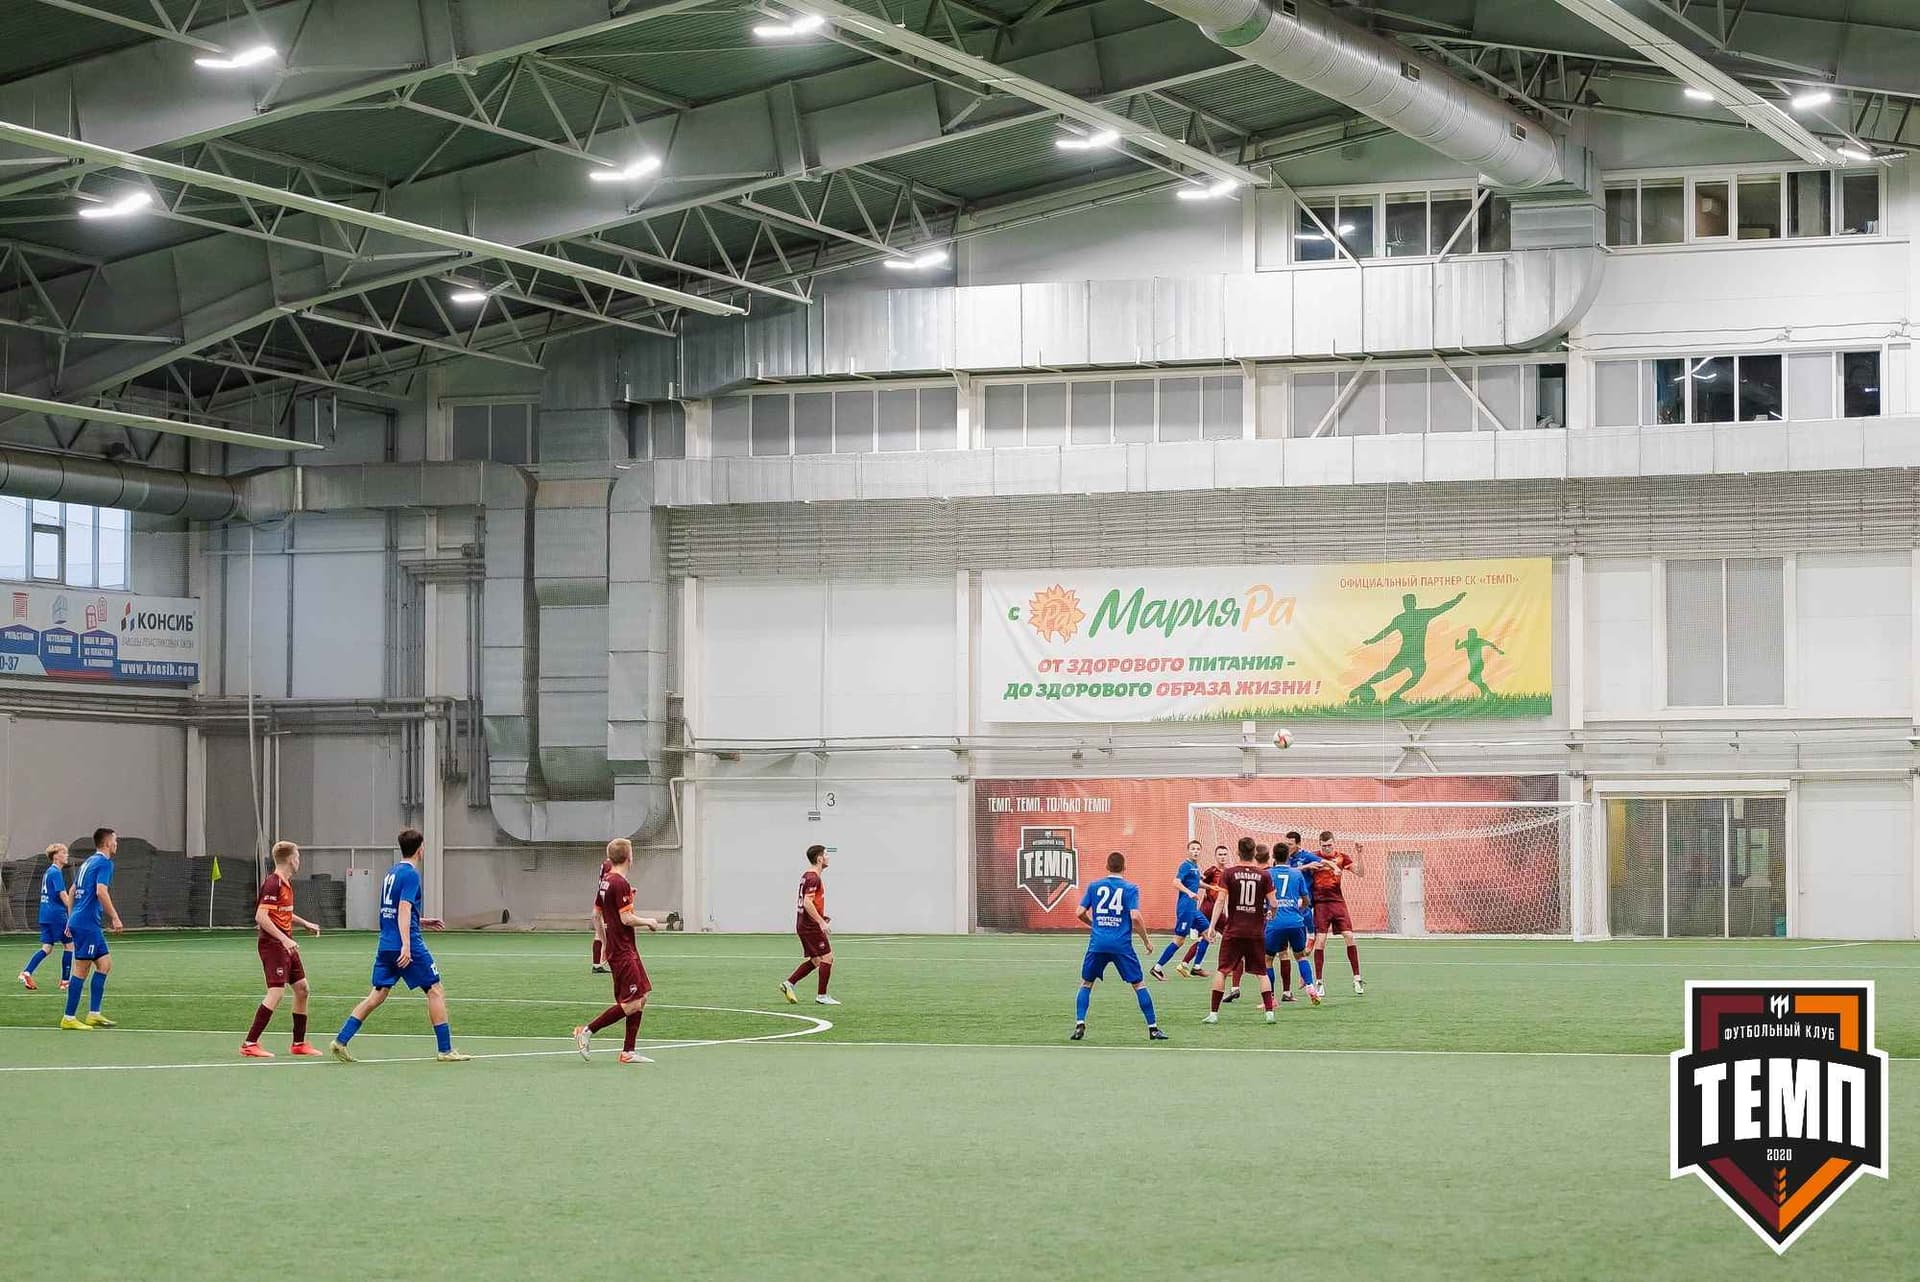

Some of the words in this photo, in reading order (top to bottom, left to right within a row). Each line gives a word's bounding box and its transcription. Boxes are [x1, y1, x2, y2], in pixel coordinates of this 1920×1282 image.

[1339, 575, 1418, 589] ОФИЦИАЛЬНЫЙ
[1420, 575, 1462, 587] ПАРТНЕР
[1465, 576, 1476, 585] СК
[138, 612, 193, 631] КОНСИБ
[121, 662, 195, 677] www.konsib.com
[1038, 658, 1063, 673] ОТ
[1067, 657, 1184, 676] ЗДОРОВОГО
[1188, 655, 1284, 672] ПИТАНИЯ
[1003, 682, 1032, 700] ДО
[1036, 682, 1153, 700] ЗДОРОВОГО
[1155, 681, 1232, 697] ОБРАЗА
[826, 793, 836, 808] 3
[988, 797, 1013, 814] ТЕМП,
[1016, 797, 1044, 813] ТЕМП,
[1046, 797, 1081, 812] ТОЛЬКО
[1023, 850, 1074, 880] ТЕМП
[383, 873, 396, 905] 12
[1239, 880, 1257, 906] 10
[1277, 874, 1289, 898] 7
[1095, 886, 1124, 915] 24
